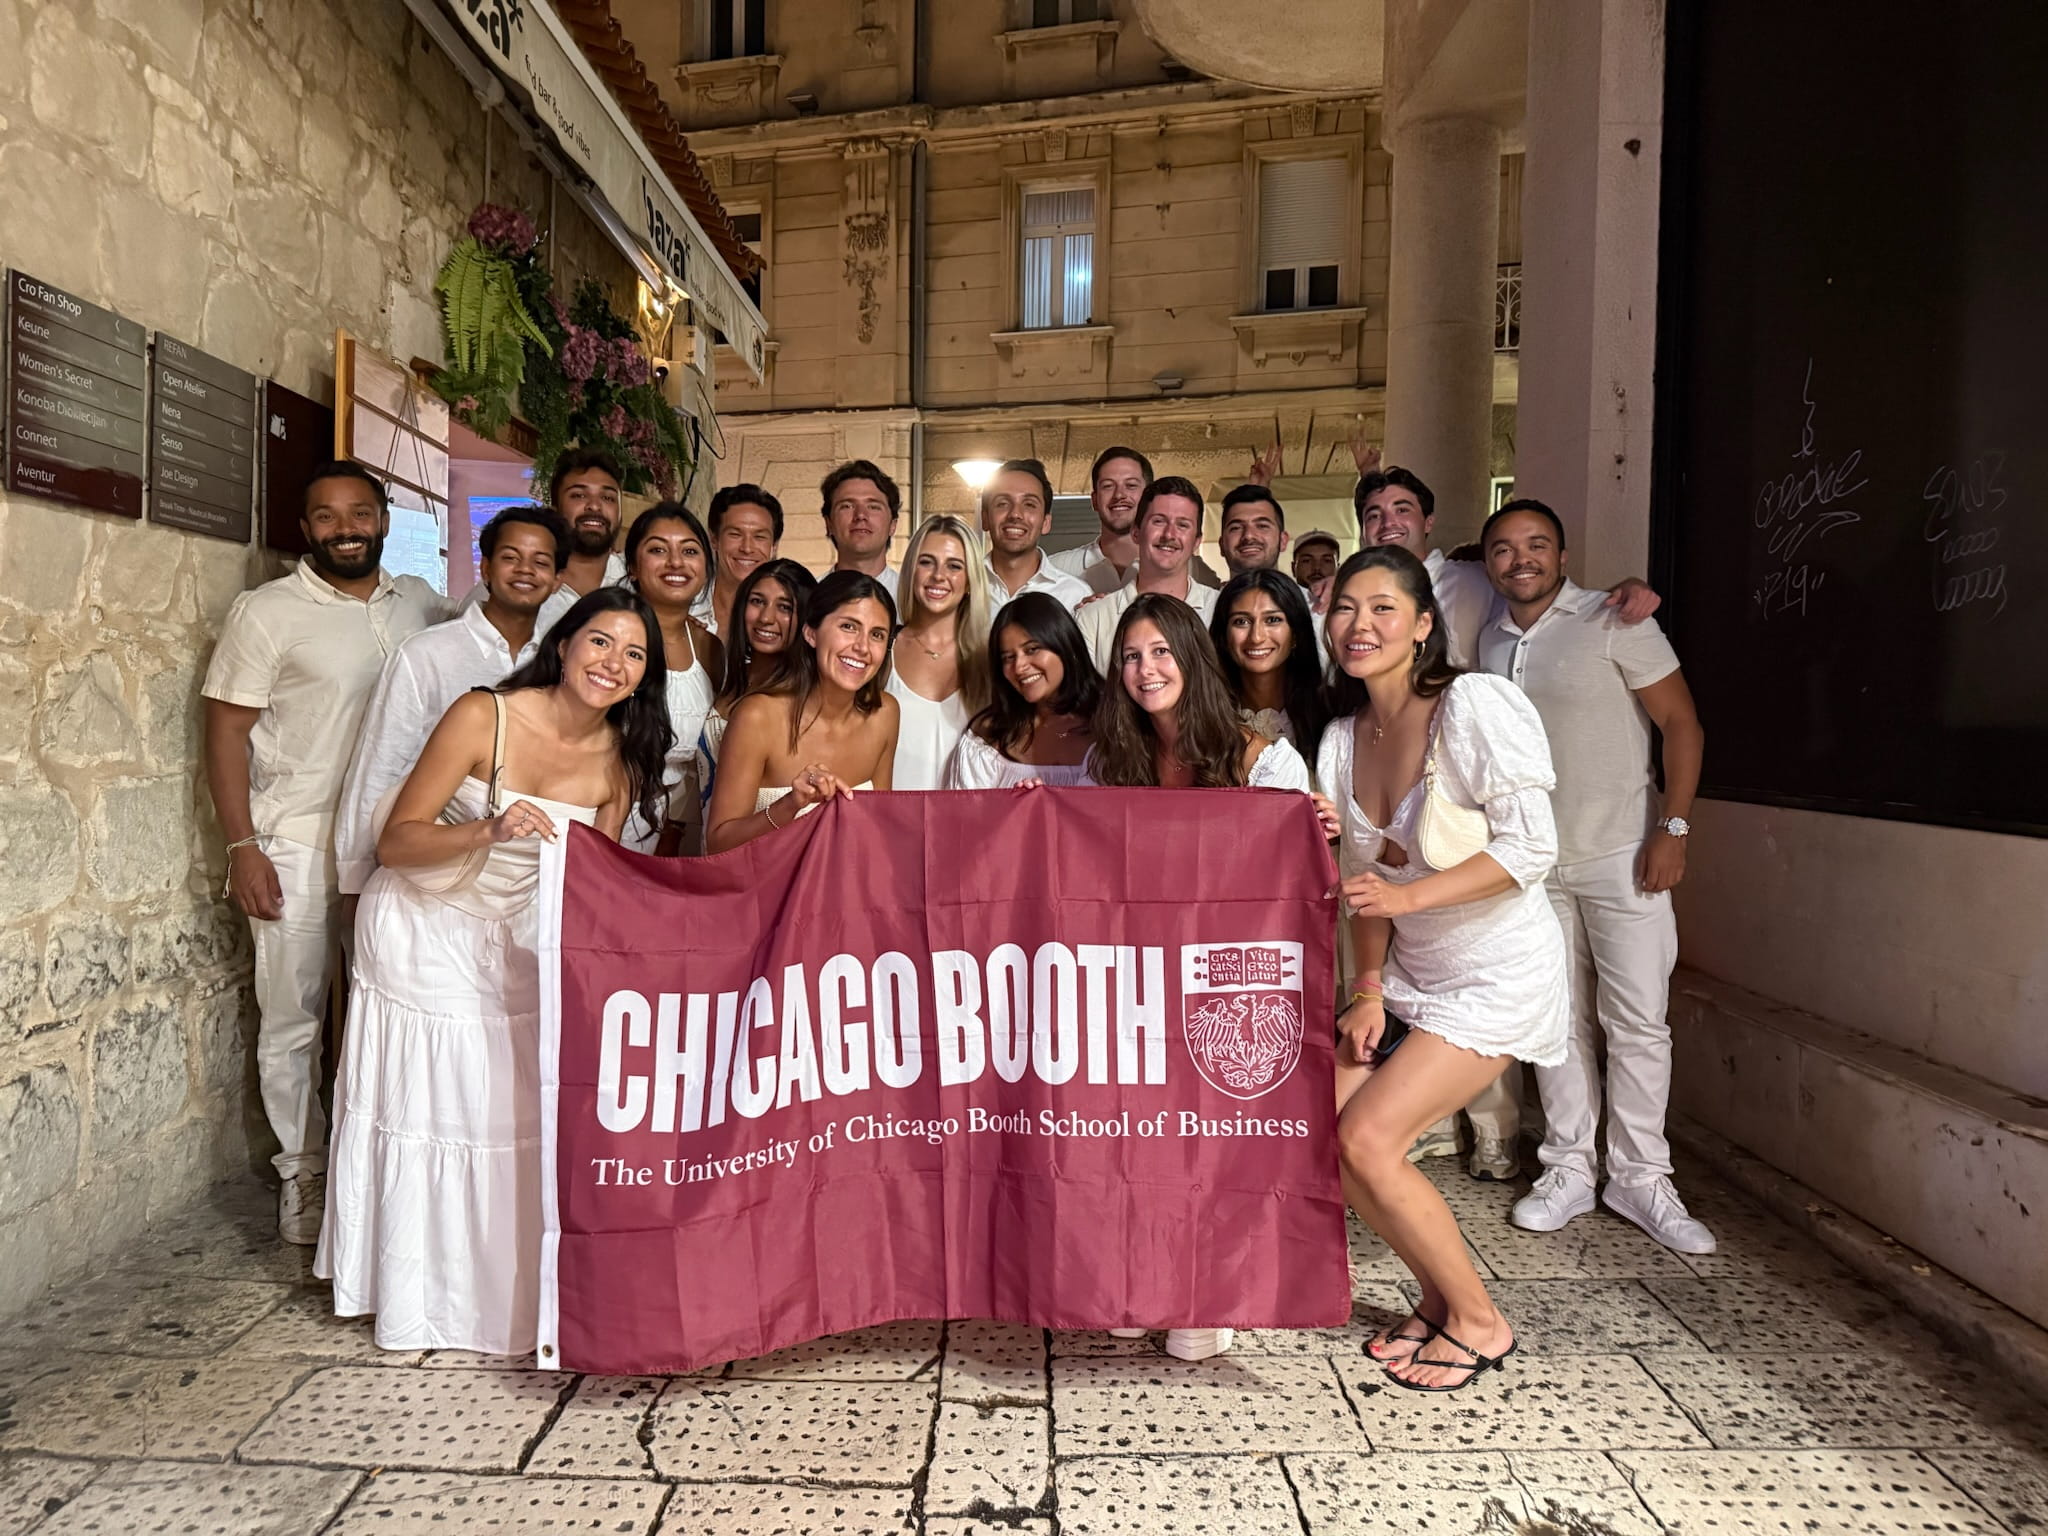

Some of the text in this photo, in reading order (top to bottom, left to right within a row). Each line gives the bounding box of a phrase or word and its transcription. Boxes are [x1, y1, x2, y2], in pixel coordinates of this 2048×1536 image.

[538, 78, 552, 105] bar
[18, 277, 36, 297] Cro
[38, 286, 56, 305] Fan
[57, 294, 82, 317] Shop
[18, 315, 50, 340] Keune
[163, 339, 188, 360] REFAN
[18, 352, 62, 379] Women's
[64, 368, 93, 390] Secret
[162, 371, 183, 389] Open
[184, 379, 207, 400] Atelier
[17, 388, 55, 412] Konoba
[162, 402, 182, 420] Nena
[16, 424, 58, 449] Connect
[161, 433, 183, 451] Senso
[16, 462, 56, 484] Aventur
[160, 465, 173, 480] Joe
[174, 469, 199, 489] Design
[1249, 949, 1276, 961] Vita
[1247, 971, 1278, 981] latur
[596, 941, 1167, 1134] CHICAGO BOOTH
[591, 1106, 1309, 1187] The University of Chicago Booth School of Business
